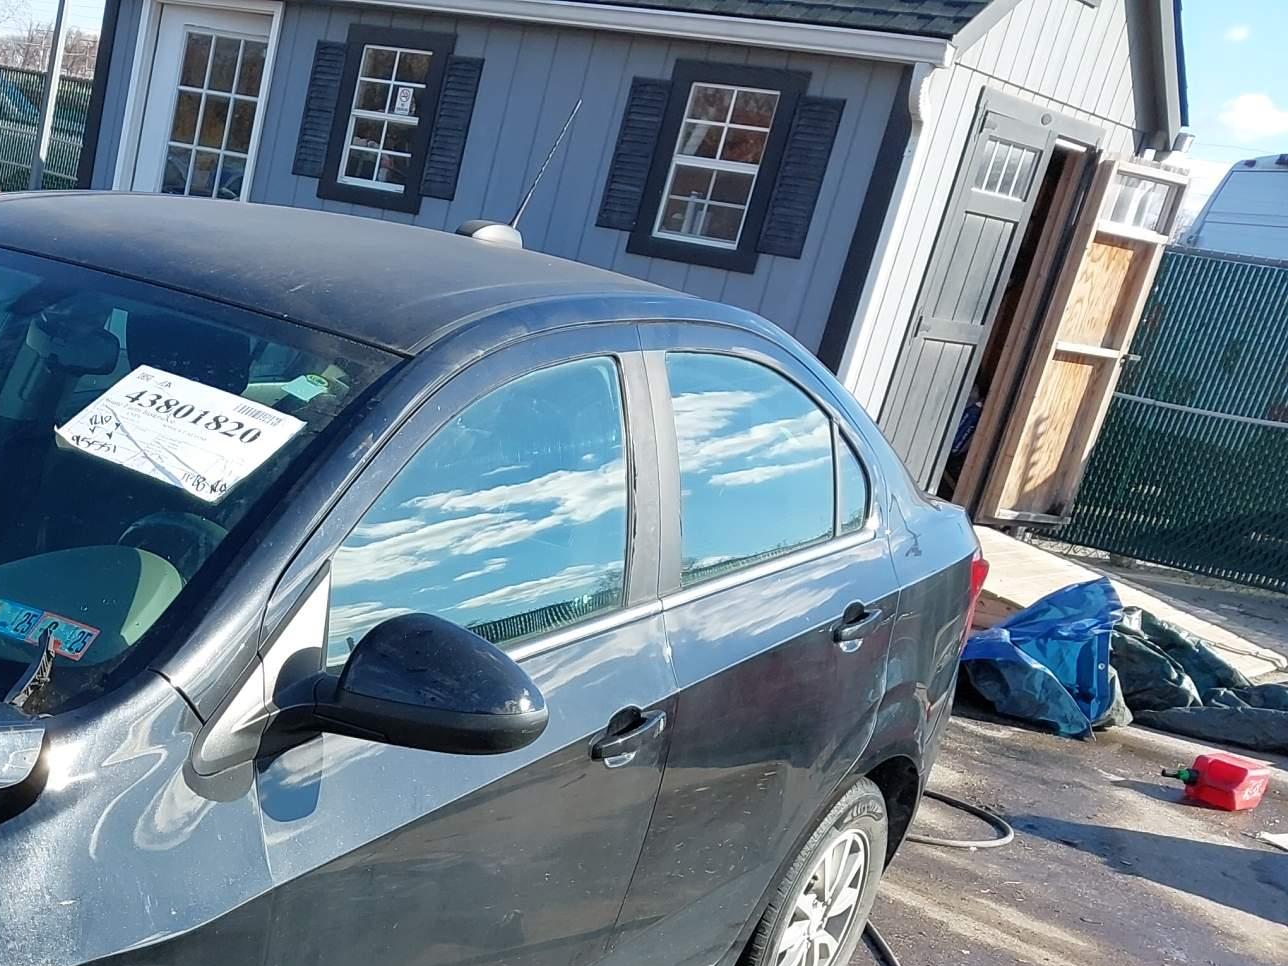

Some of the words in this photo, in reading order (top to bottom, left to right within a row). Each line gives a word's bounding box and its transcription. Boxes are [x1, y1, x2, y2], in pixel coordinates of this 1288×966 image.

[125, 390, 261, 443] 43801820
[14, 612, 37, 633] 25
[68, 630, 92, 653] 25
